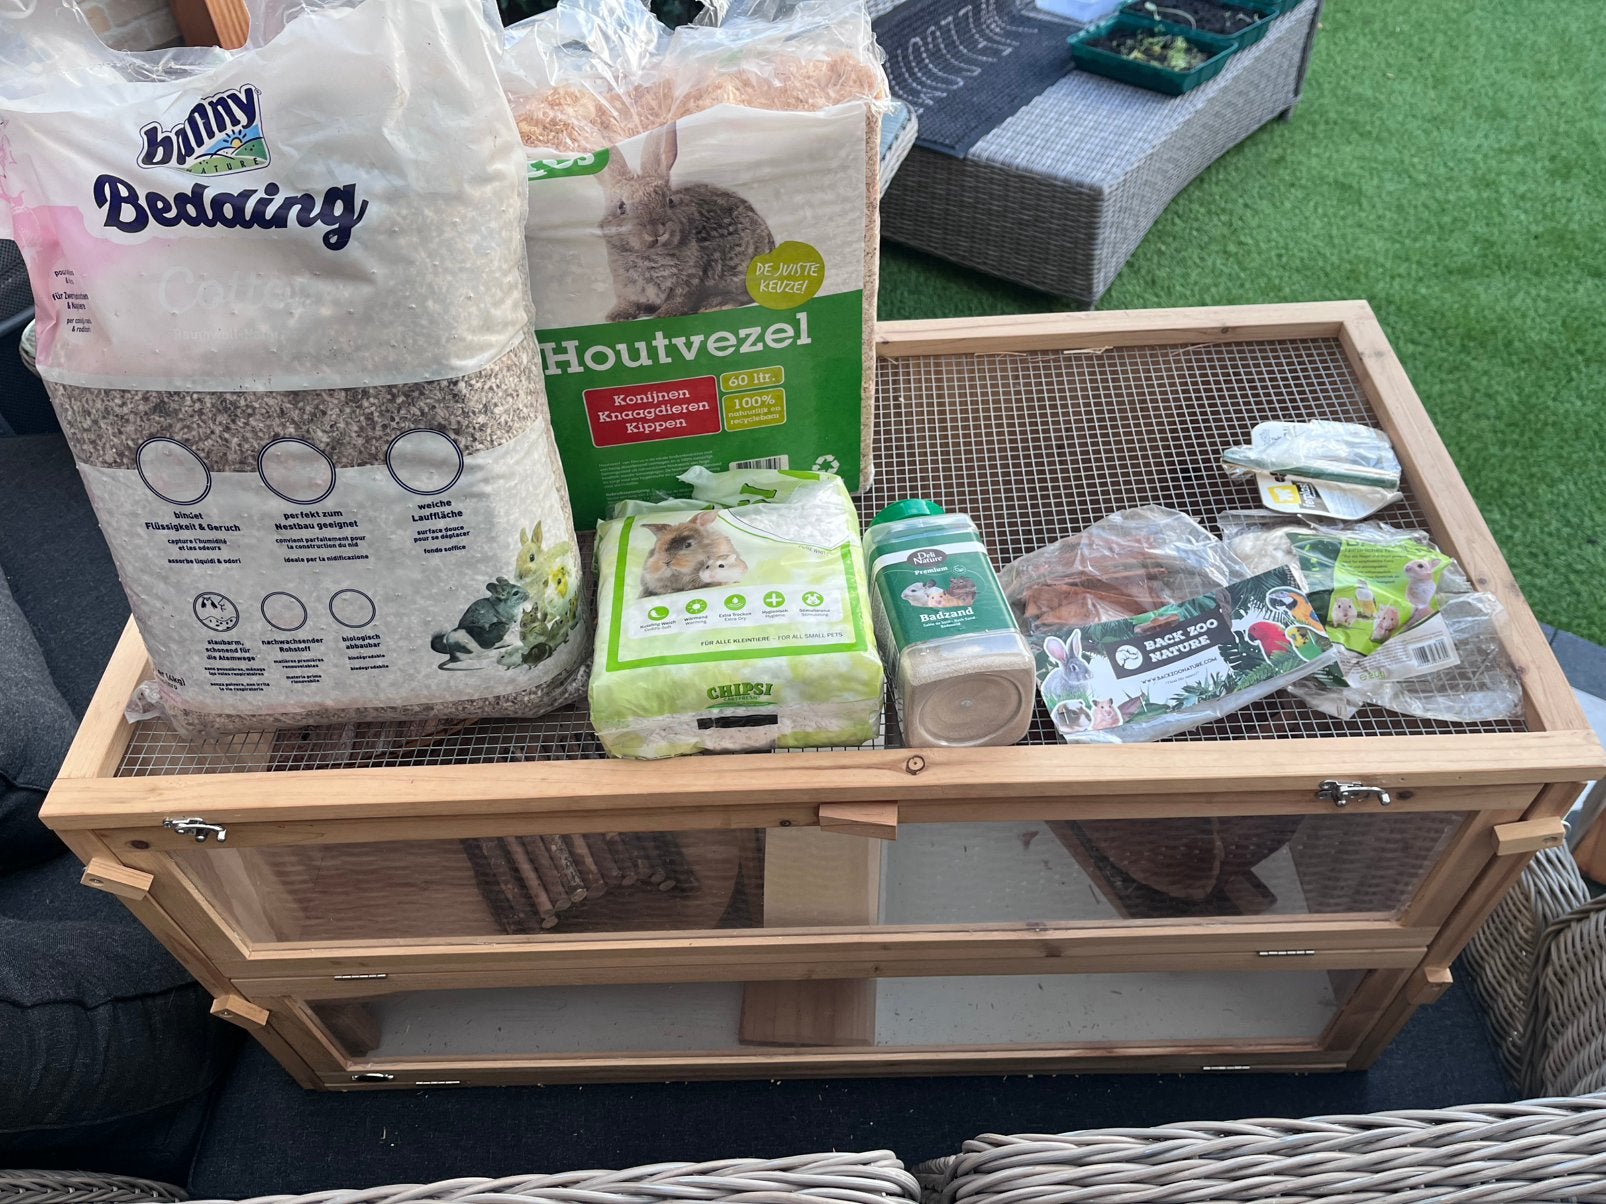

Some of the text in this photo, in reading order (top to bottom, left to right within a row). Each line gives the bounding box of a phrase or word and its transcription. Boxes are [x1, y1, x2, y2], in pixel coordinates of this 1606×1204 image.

[756, 262, 820, 276] DE JUISTE
[759, 279, 807, 294] KEUZE!
[539, 312, 812, 375] Houtvezel
[728, 372, 776, 386] 60 ltr.
[613, 387, 690, 406] Konijnen
[734, 394, 775, 409] 100%
[598, 399, 710, 422] Knaagdieren
[728, 408, 768, 418] natuurlijk
[626, 416, 687, 434] Kippen
[730, 414, 780, 424] recyclebaar
[417, 500, 452, 510] weiche
[174, 511, 203, 520] bindet
[284, 510, 320, 520] perfekt
[412, 509, 463, 522] Lauffläche
[145, 522, 197, 532] Flüssigkeit
[207, 523, 240, 532] Geruch
[275, 520, 358, 531] Nestbau geeignet
[440, 530, 470, 539] déplacer
[328, 554, 369, 562] nidificazione
[913, 556, 943, 565] Nature
[918, 551, 936, 560] Deli
[914, 566, 948, 576] Premium
[920, 606, 974, 622] Badzand
[342, 634, 381, 642] biologisch
[1144, 618, 1219, 650] BACK ZOO
[1149, 635, 1211, 664] NATURE
[706, 682, 773, 700] CHIPSI
